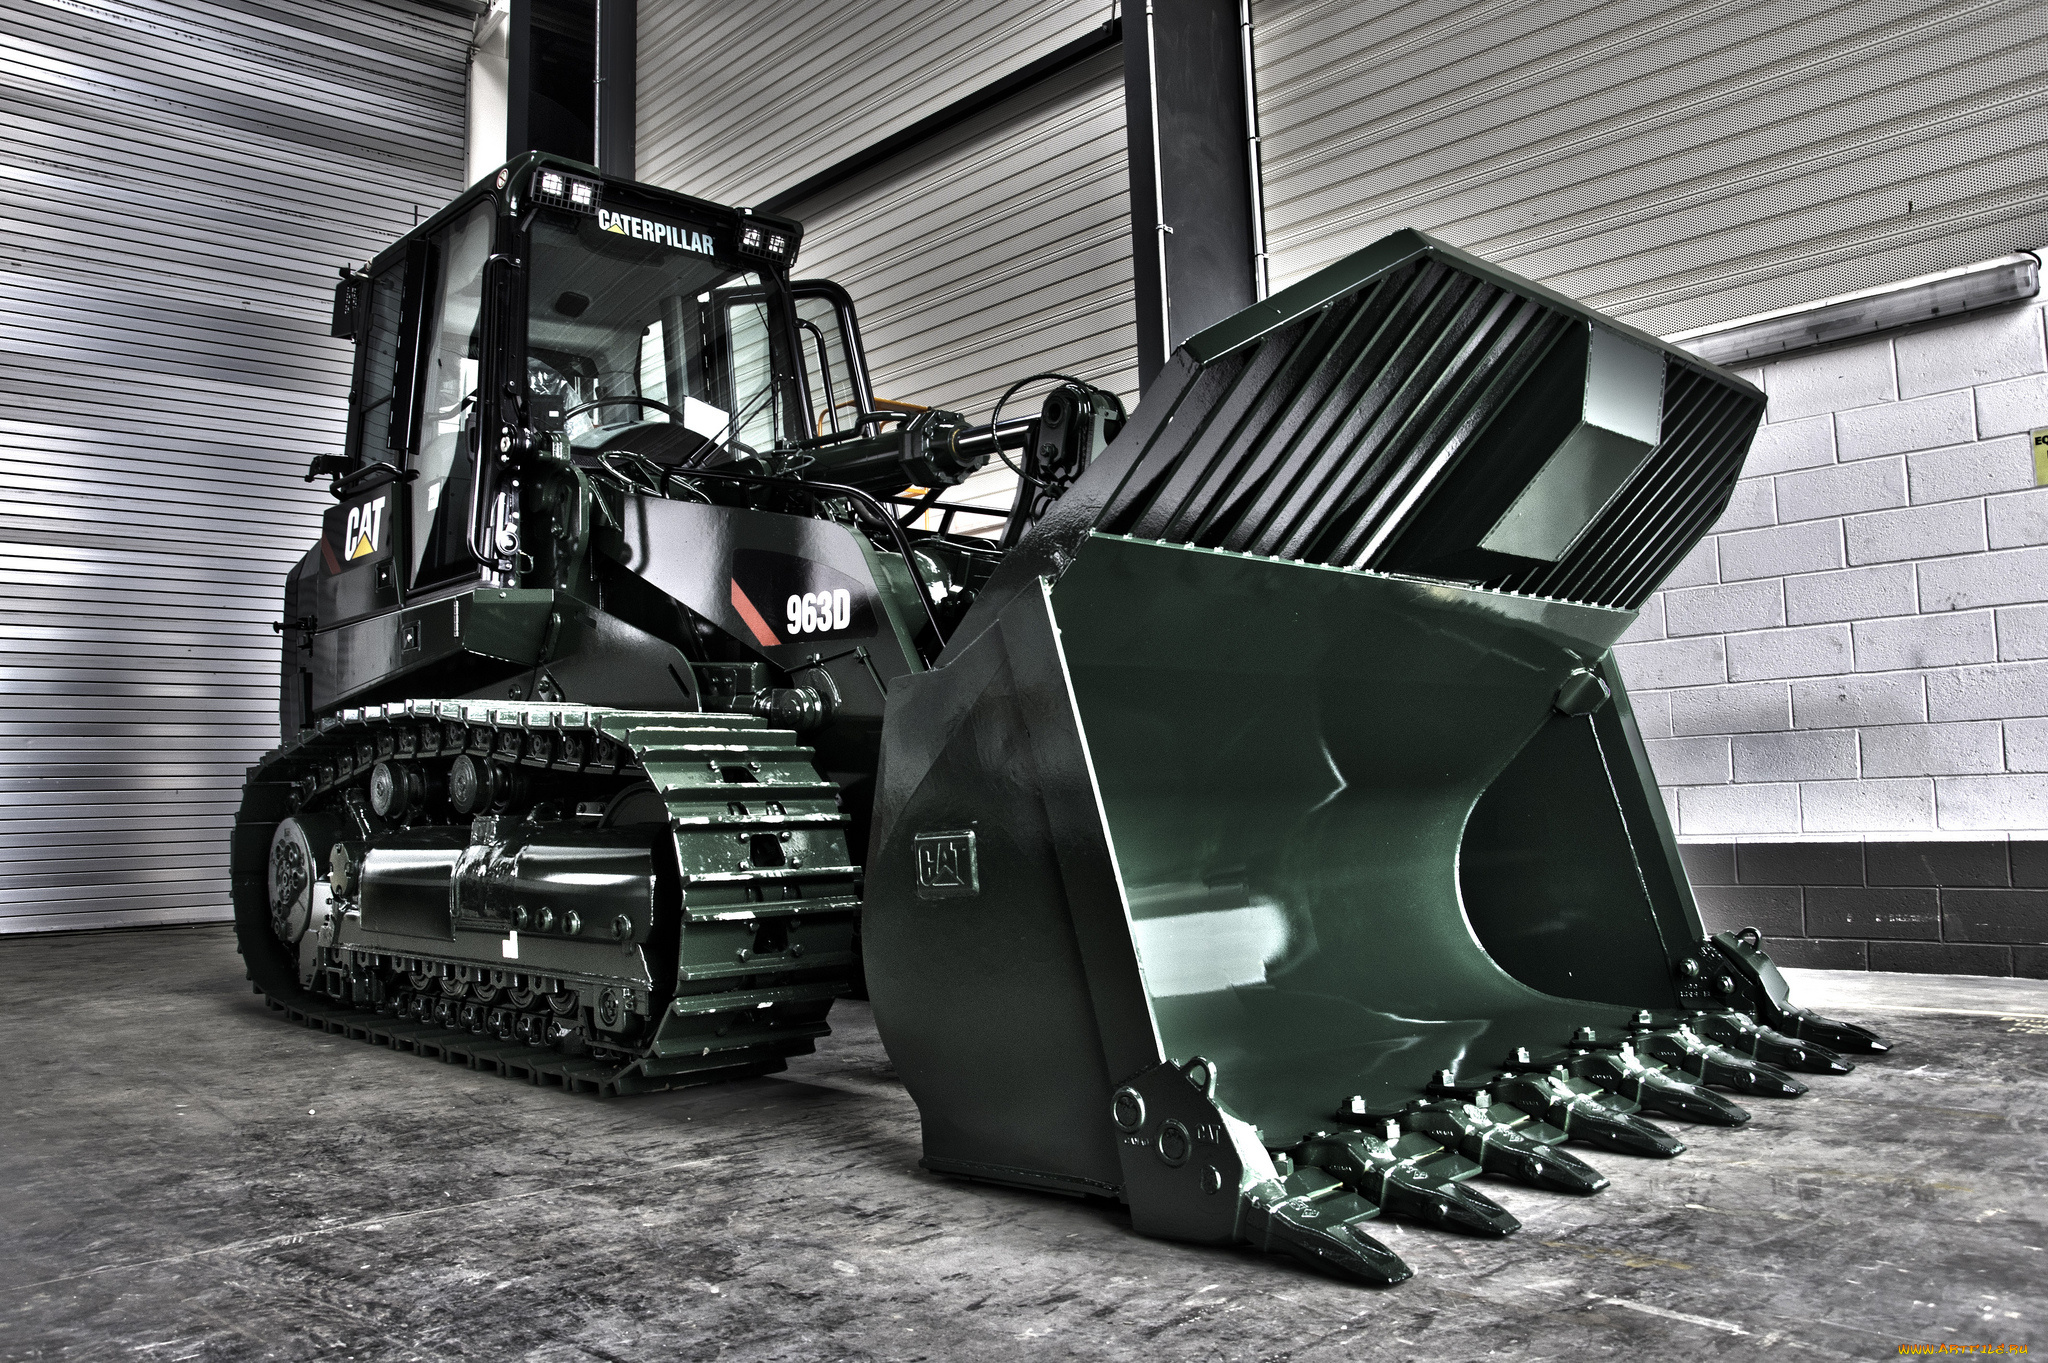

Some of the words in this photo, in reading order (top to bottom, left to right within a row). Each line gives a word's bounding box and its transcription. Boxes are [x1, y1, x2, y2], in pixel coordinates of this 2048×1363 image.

[598, 208, 715, 256] CATERPILLAR
[344, 496, 386, 561] CAT
[787, 588, 851, 635] 963D
